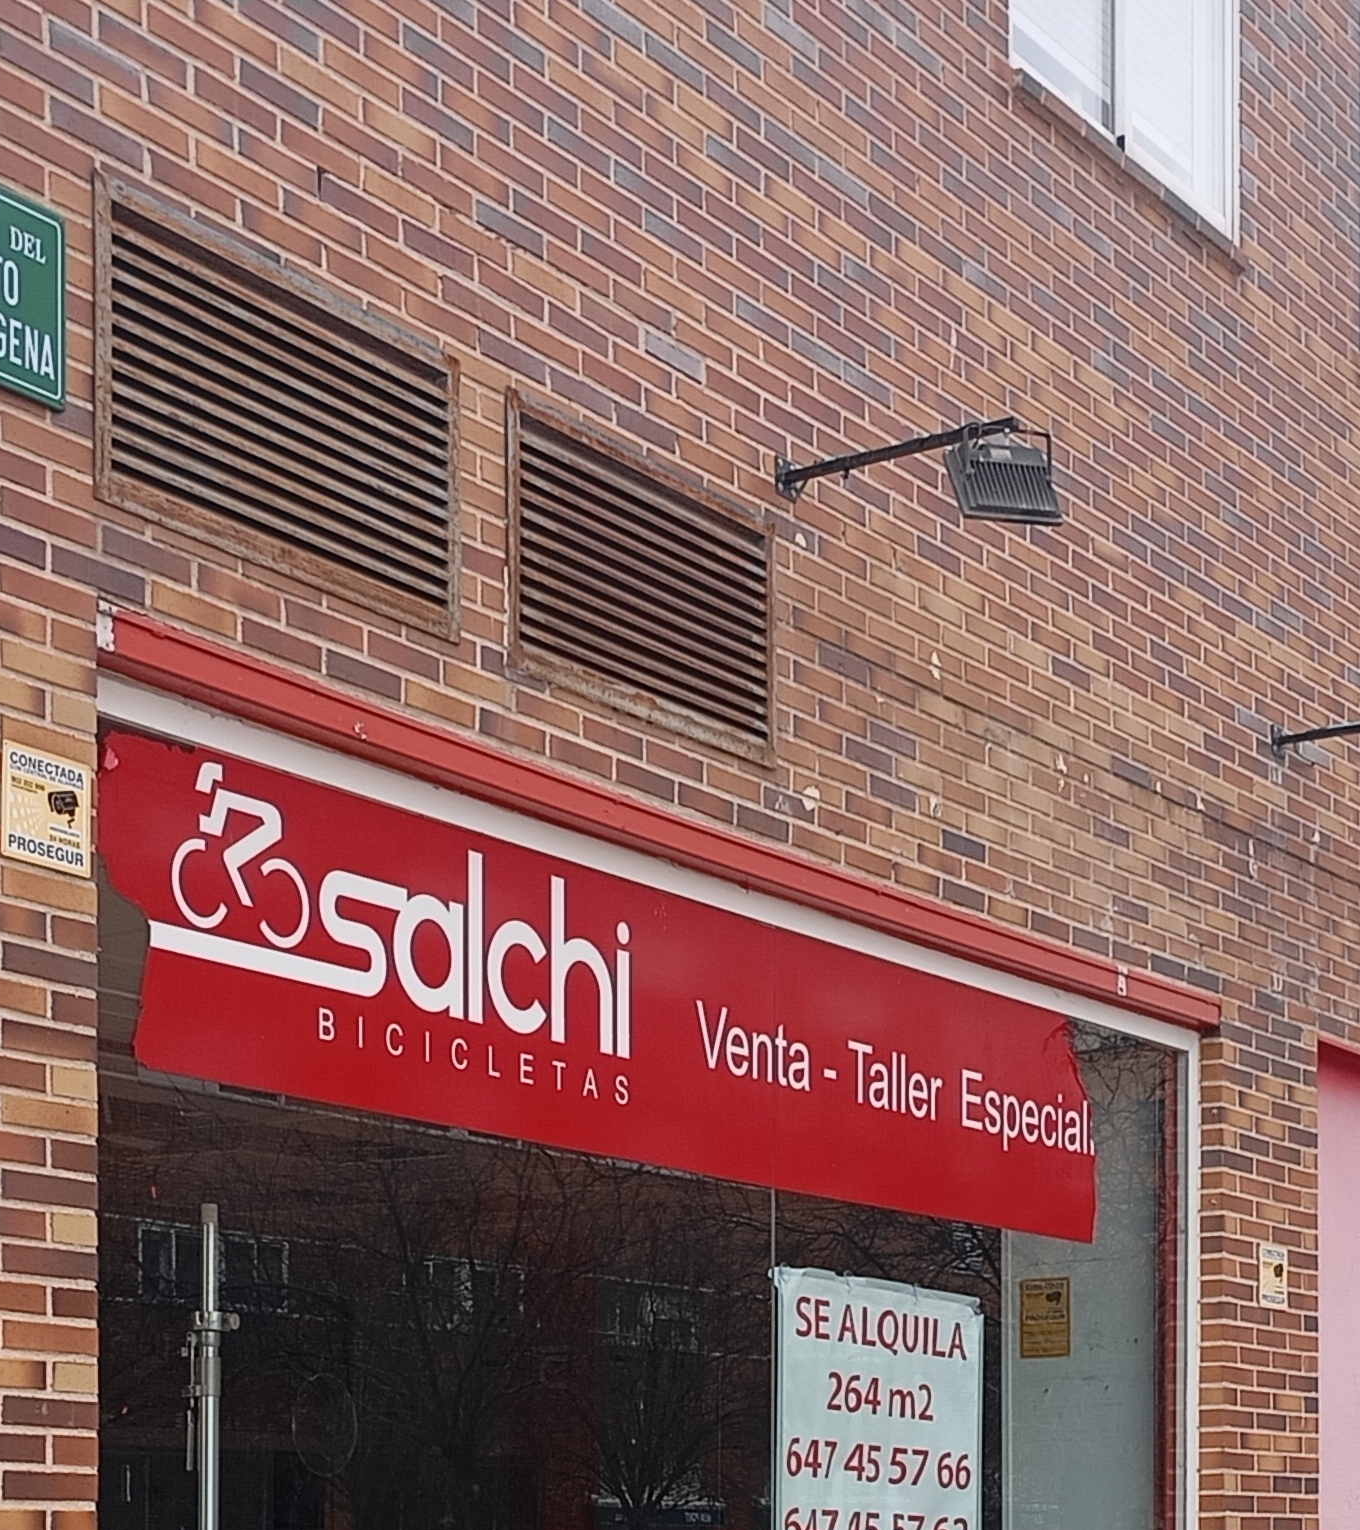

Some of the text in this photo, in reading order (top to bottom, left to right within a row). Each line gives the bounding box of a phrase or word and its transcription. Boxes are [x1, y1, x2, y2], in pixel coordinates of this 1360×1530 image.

[9, 225, 47, 265] DEL
[9, 751, 84, 785] CONECTADA
[8, 833, 84, 867] PROSEGUR
[318, 849, 631, 1059] salchi
[318, 1007, 630, 1105] BICICLETAS
[695, 1000, 811, 1092] Venta
[848, 1040, 942, 1121] Taller
[795, 1296, 830, 1340] SE
[837, 1303, 967, 1361] ALQUILA
[826, 1371, 934, 1421] 264 m2
[786, 1437, 971, 1490] 647 45 57 66
